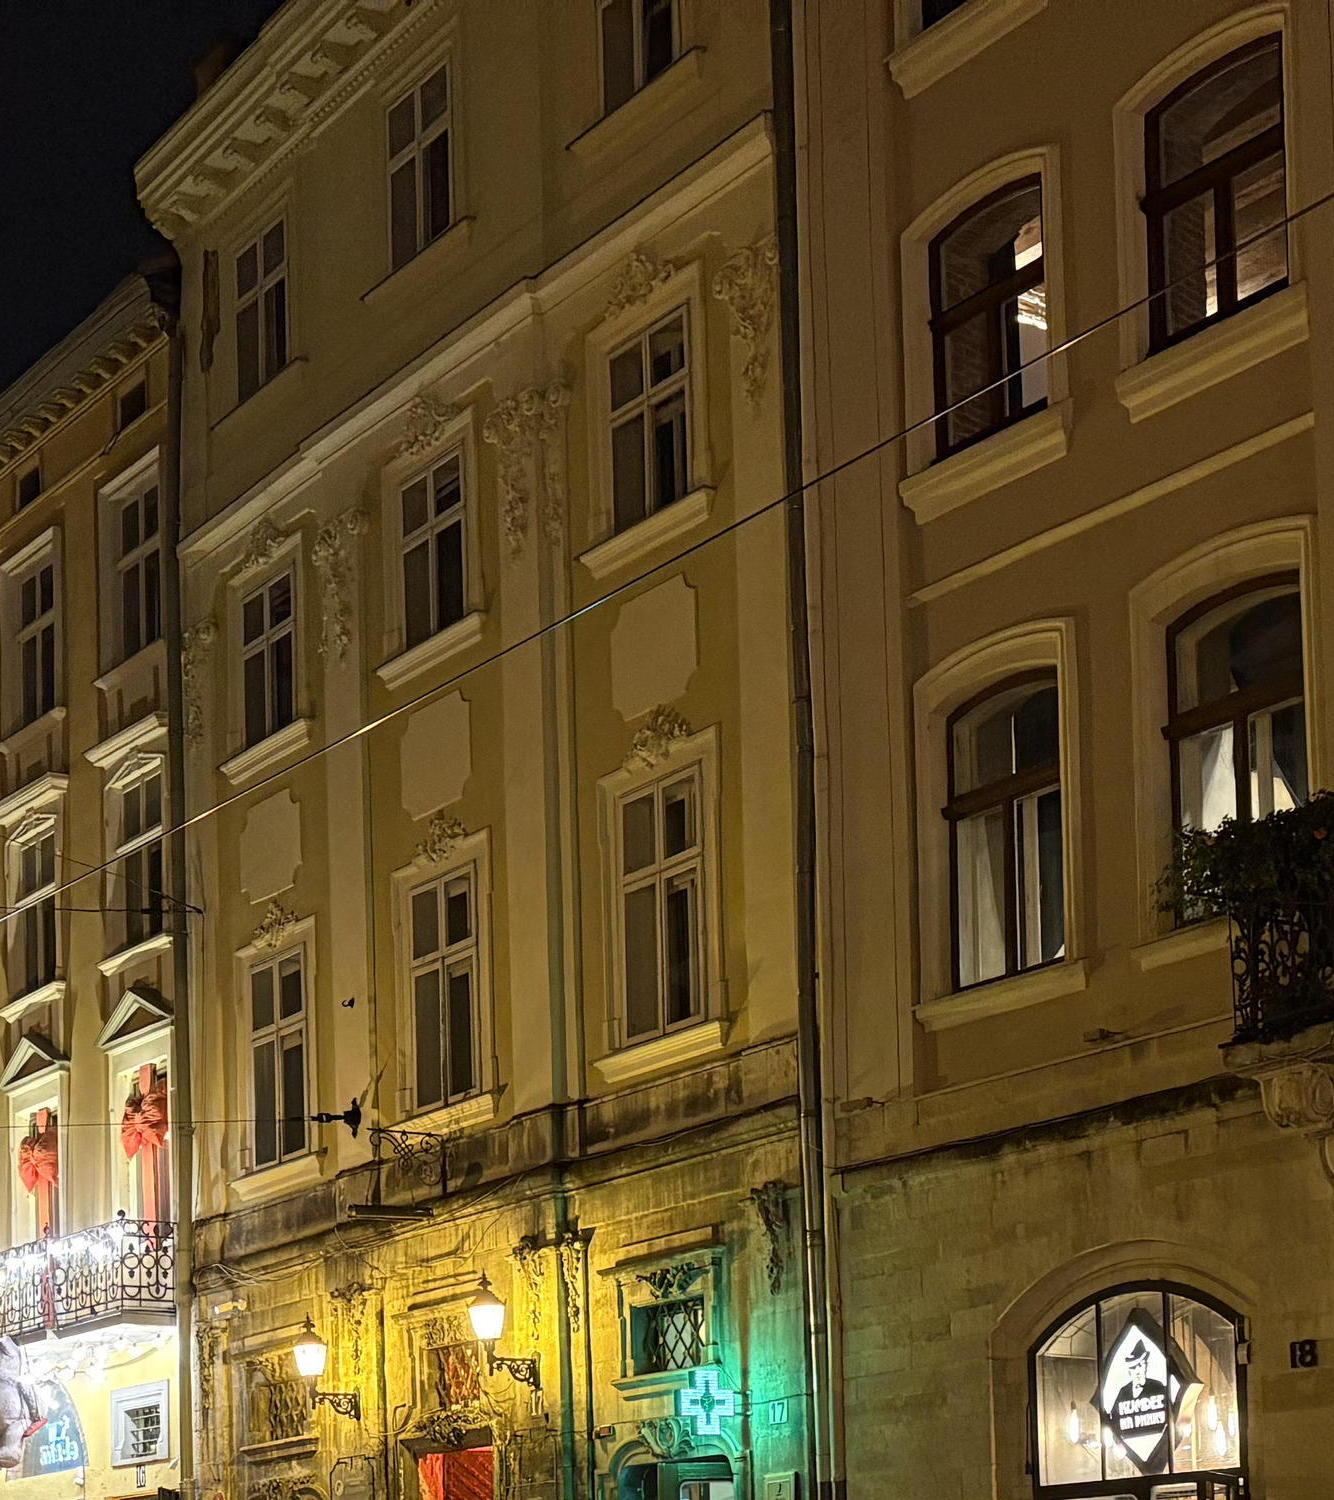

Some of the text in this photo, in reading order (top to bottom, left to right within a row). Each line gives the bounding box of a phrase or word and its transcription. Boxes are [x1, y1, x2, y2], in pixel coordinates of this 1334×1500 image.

[1289, 1338, 1319, 1369] 18
[770, 1401, 785, 1423] 17
[136, 1465, 146, 1487] 16
